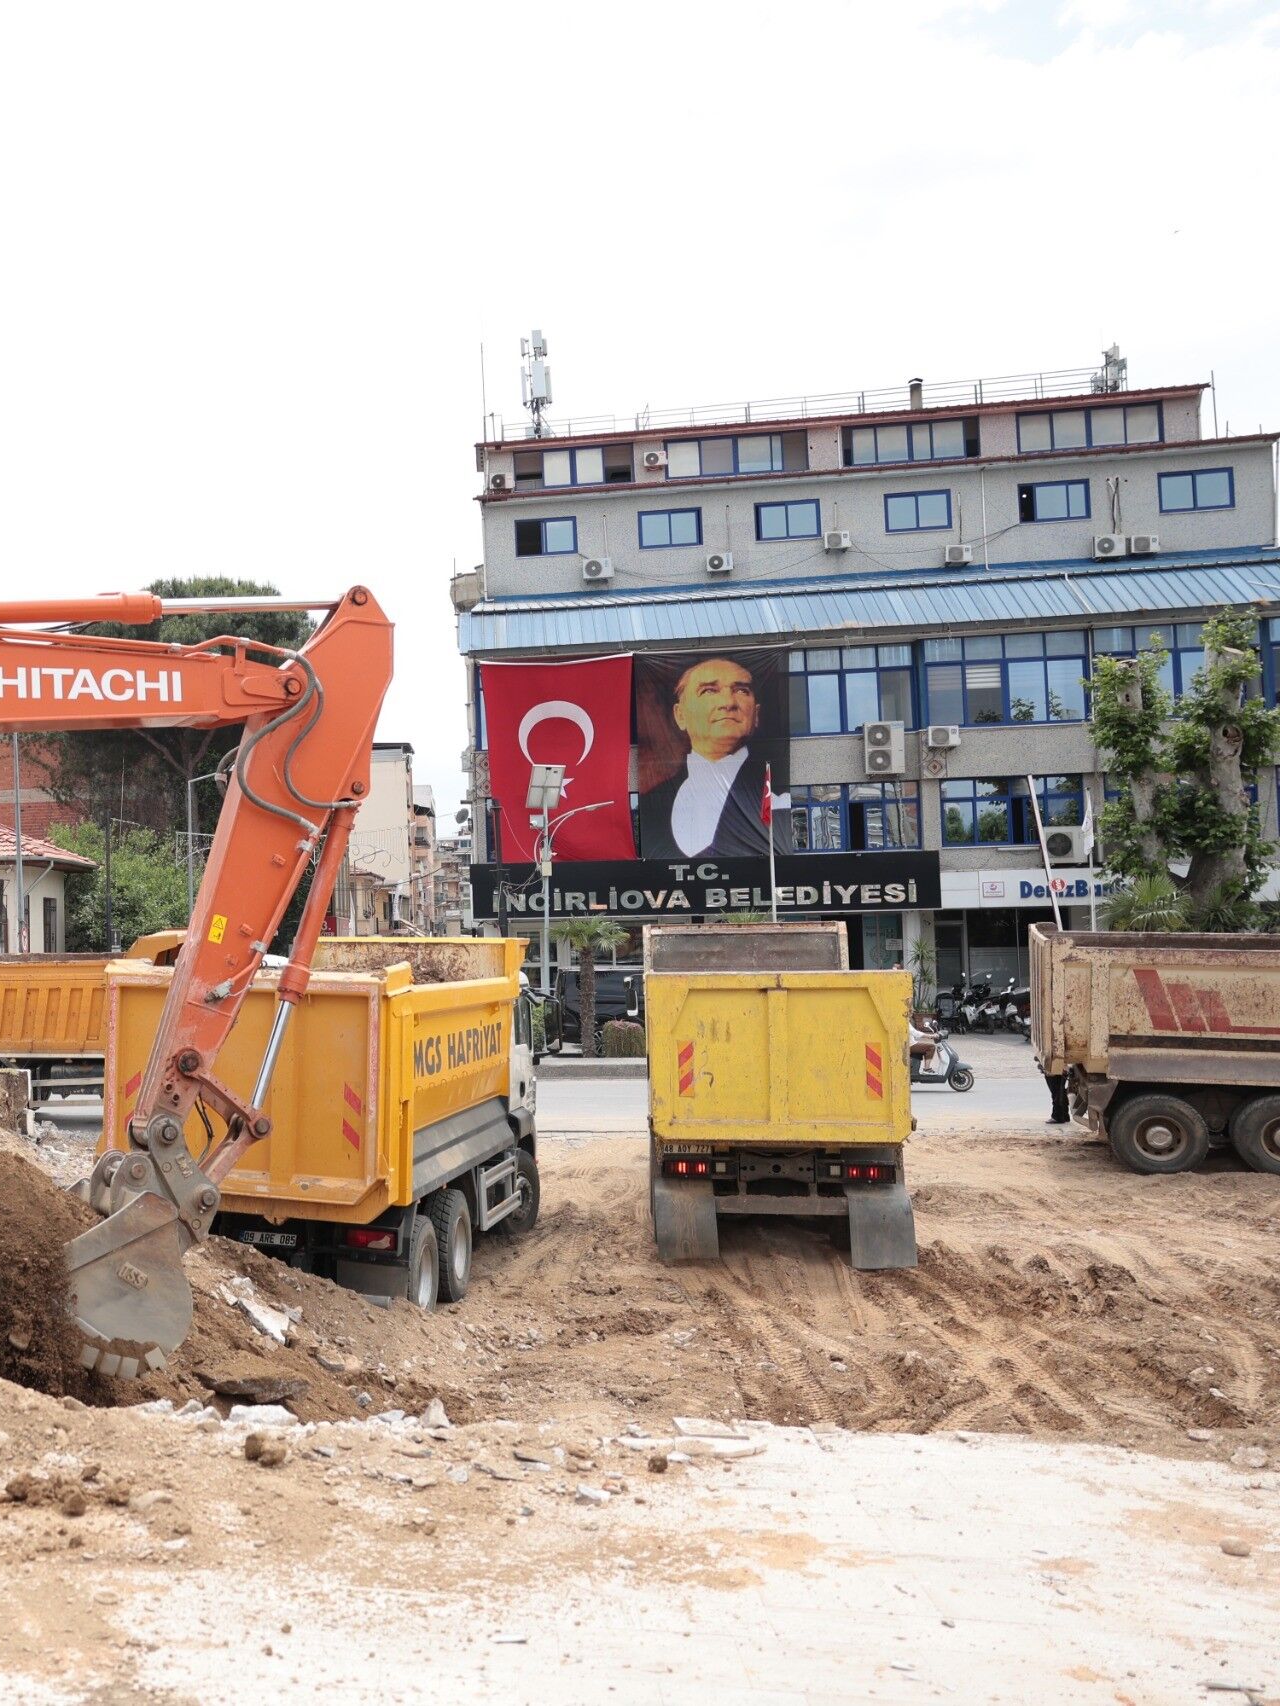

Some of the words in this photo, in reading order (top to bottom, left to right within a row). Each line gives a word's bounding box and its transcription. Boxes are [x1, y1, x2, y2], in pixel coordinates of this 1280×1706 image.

[668, 863, 730, 881] T.C.
[493, 886, 691, 912] İNCİRLİOVA
[705, 879, 917, 908] BELEDİYESİ
[413, 1035, 442, 1079] MGS
[447, 1020, 502, 1070] HAFRİYAT
[664, 1144, 674, 1152] 48
[695, 1144, 710, 1153] 727
[244, 1231, 255, 1242] 09
[260, 1232, 276, 1244] ARE
[280, 1234, 296, 1246] 085
